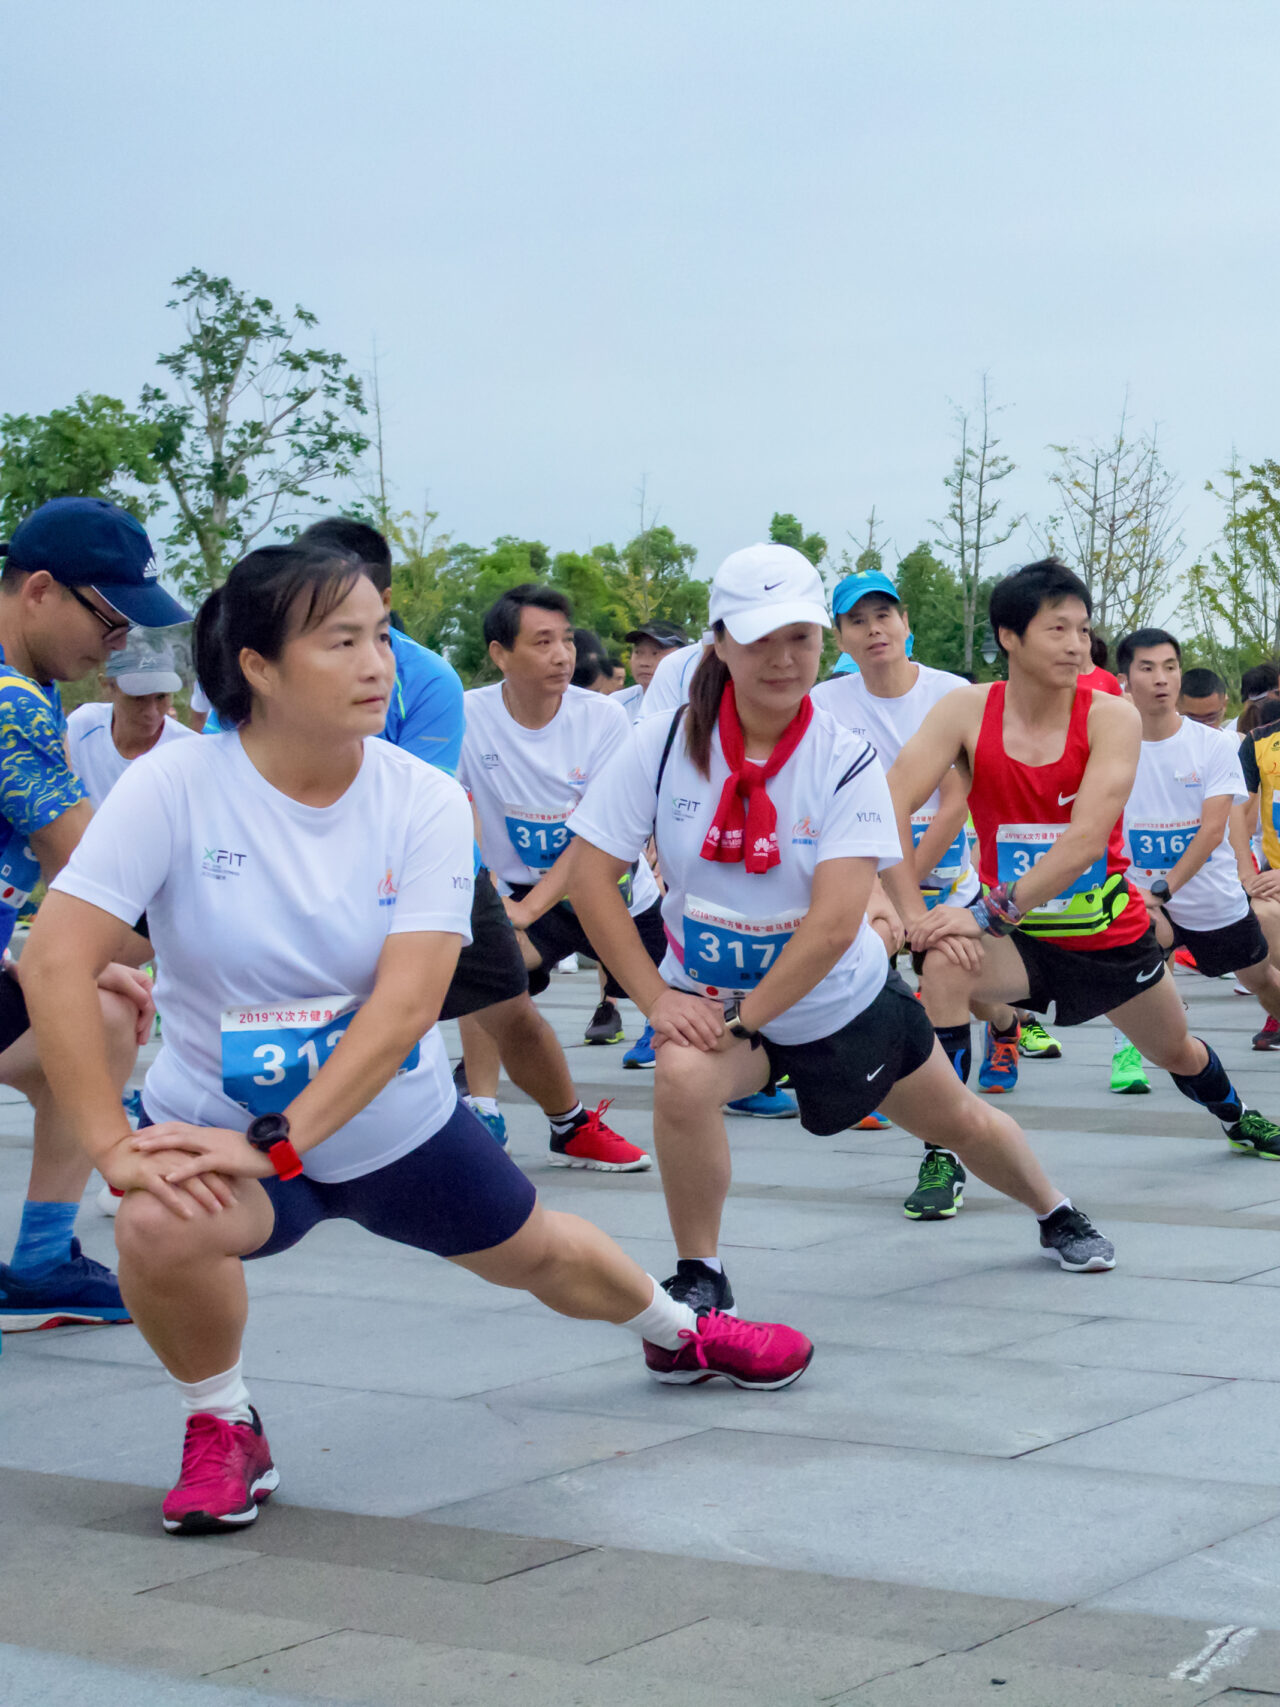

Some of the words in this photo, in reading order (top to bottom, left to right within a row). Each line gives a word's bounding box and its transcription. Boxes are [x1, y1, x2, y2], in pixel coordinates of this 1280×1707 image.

[849, 727, 867, 736] FIT
[856, 812, 882, 824] YUTA
[202, 848, 247, 867] XFIT
